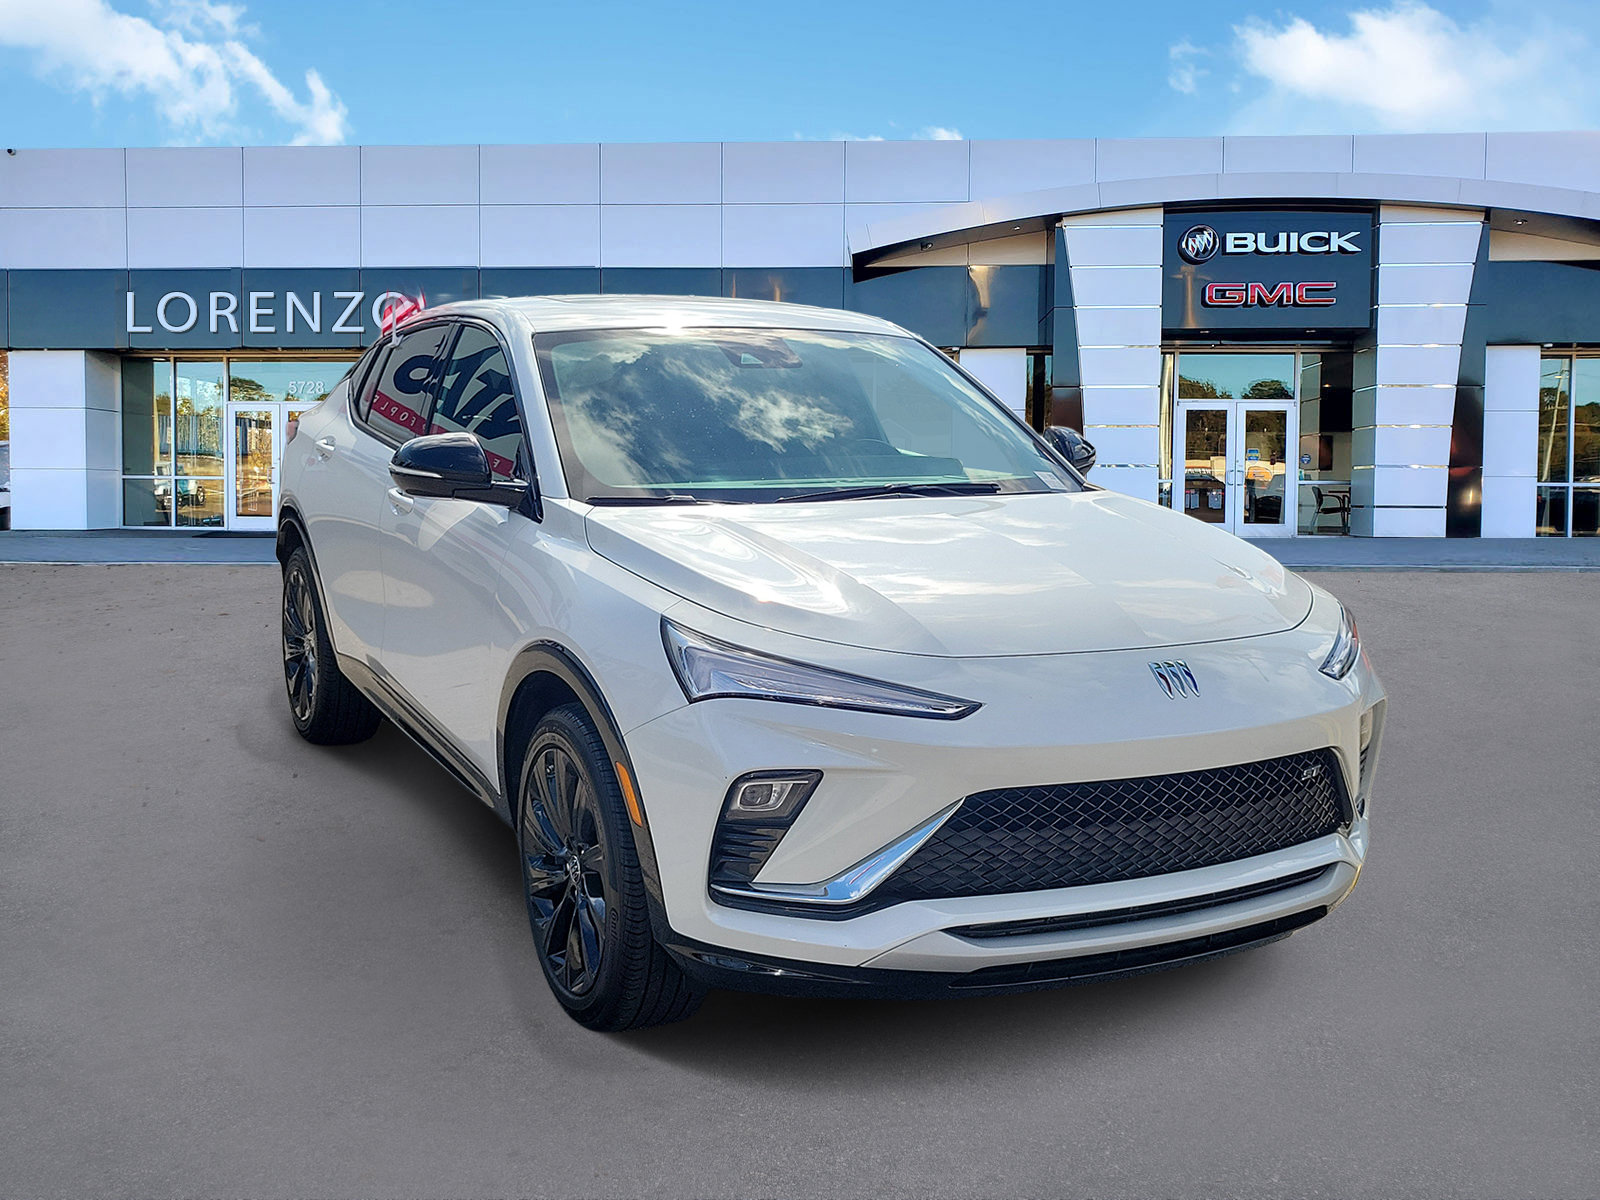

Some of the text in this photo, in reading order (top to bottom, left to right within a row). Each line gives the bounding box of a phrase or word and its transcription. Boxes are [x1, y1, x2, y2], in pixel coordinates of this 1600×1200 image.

[1226, 231, 1362, 253] BUICK
[1206, 282, 1337, 305] GMC
[126, 291, 411, 333] LORENZO
[288, 381, 325, 394] 5728
